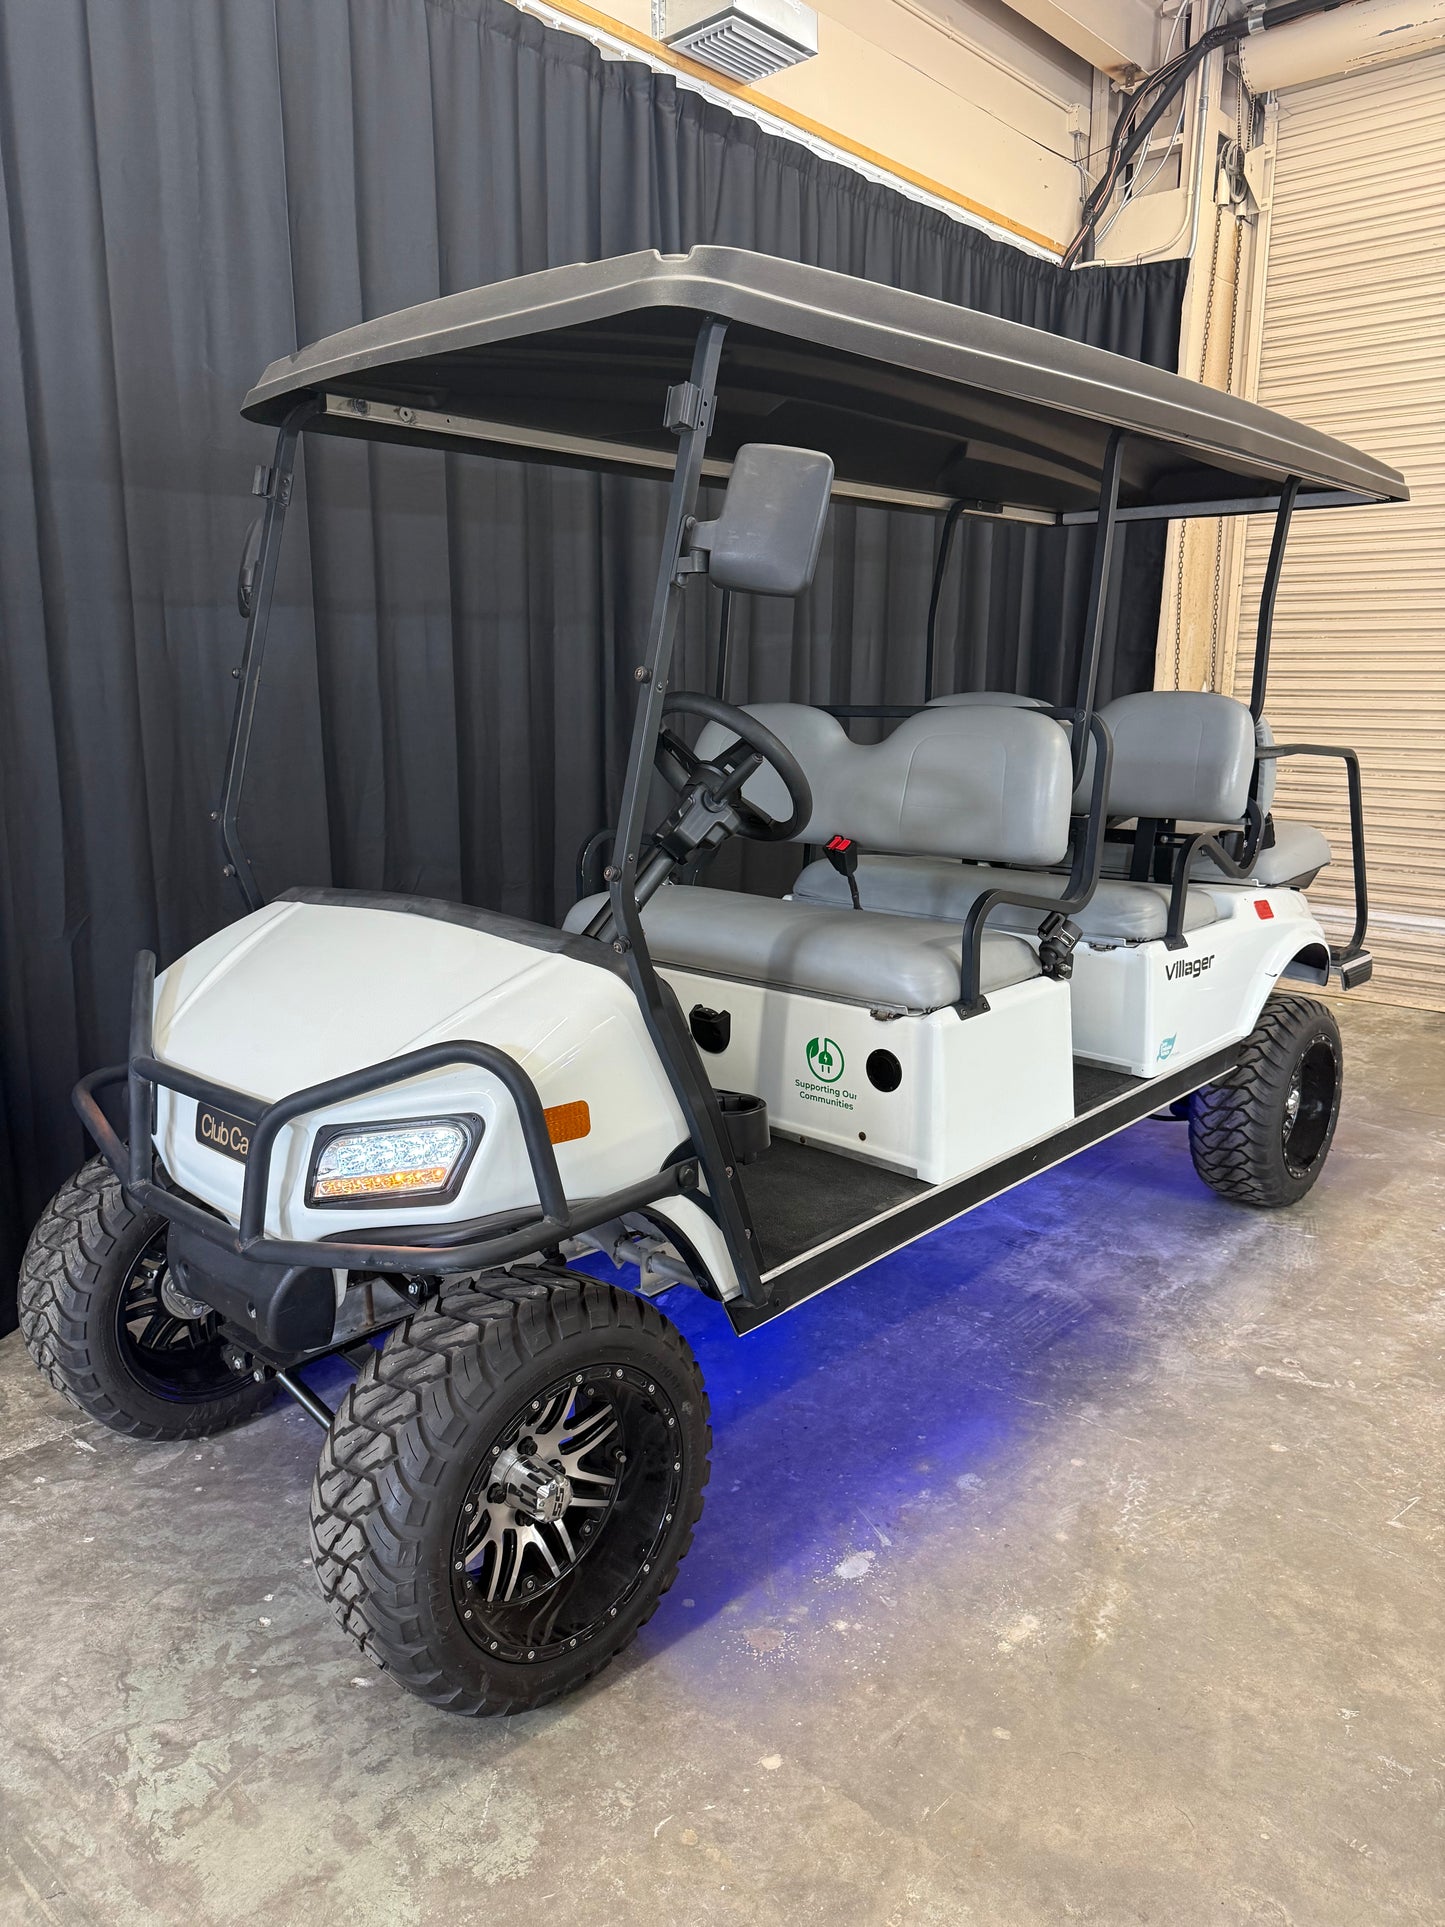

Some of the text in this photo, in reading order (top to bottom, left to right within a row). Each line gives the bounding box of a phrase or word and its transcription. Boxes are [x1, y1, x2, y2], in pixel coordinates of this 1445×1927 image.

[1165, 954, 1215, 981] Villager
[795, 1079, 840, 1097] Supporting
[799, 1091, 854, 1110] Communities
[201, 1113, 249, 1155] Club Ca
